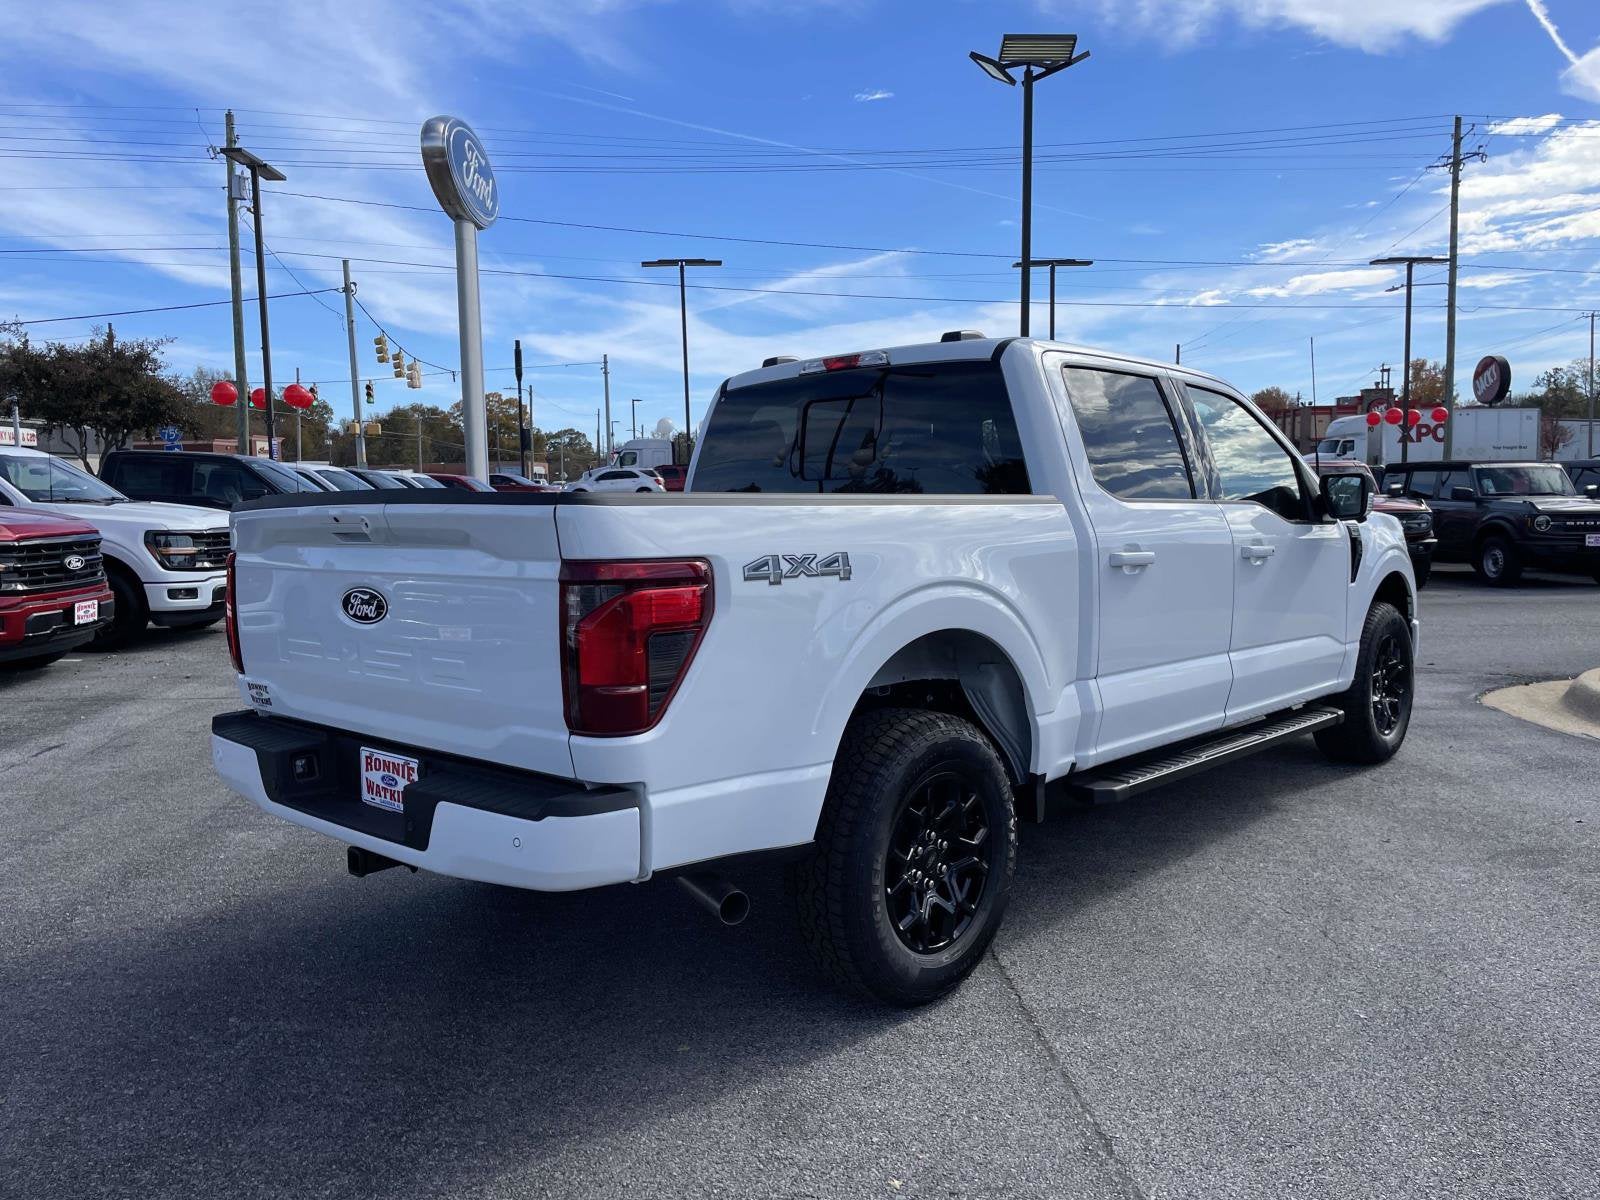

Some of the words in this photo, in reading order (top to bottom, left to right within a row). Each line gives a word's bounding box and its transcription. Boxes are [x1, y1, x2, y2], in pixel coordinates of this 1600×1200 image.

[463, 139, 493, 211] Ford
[348, 592, 378, 618] Ford
[365, 755, 416, 783] RONNIE
[365, 776, 402, 804] WATKI
